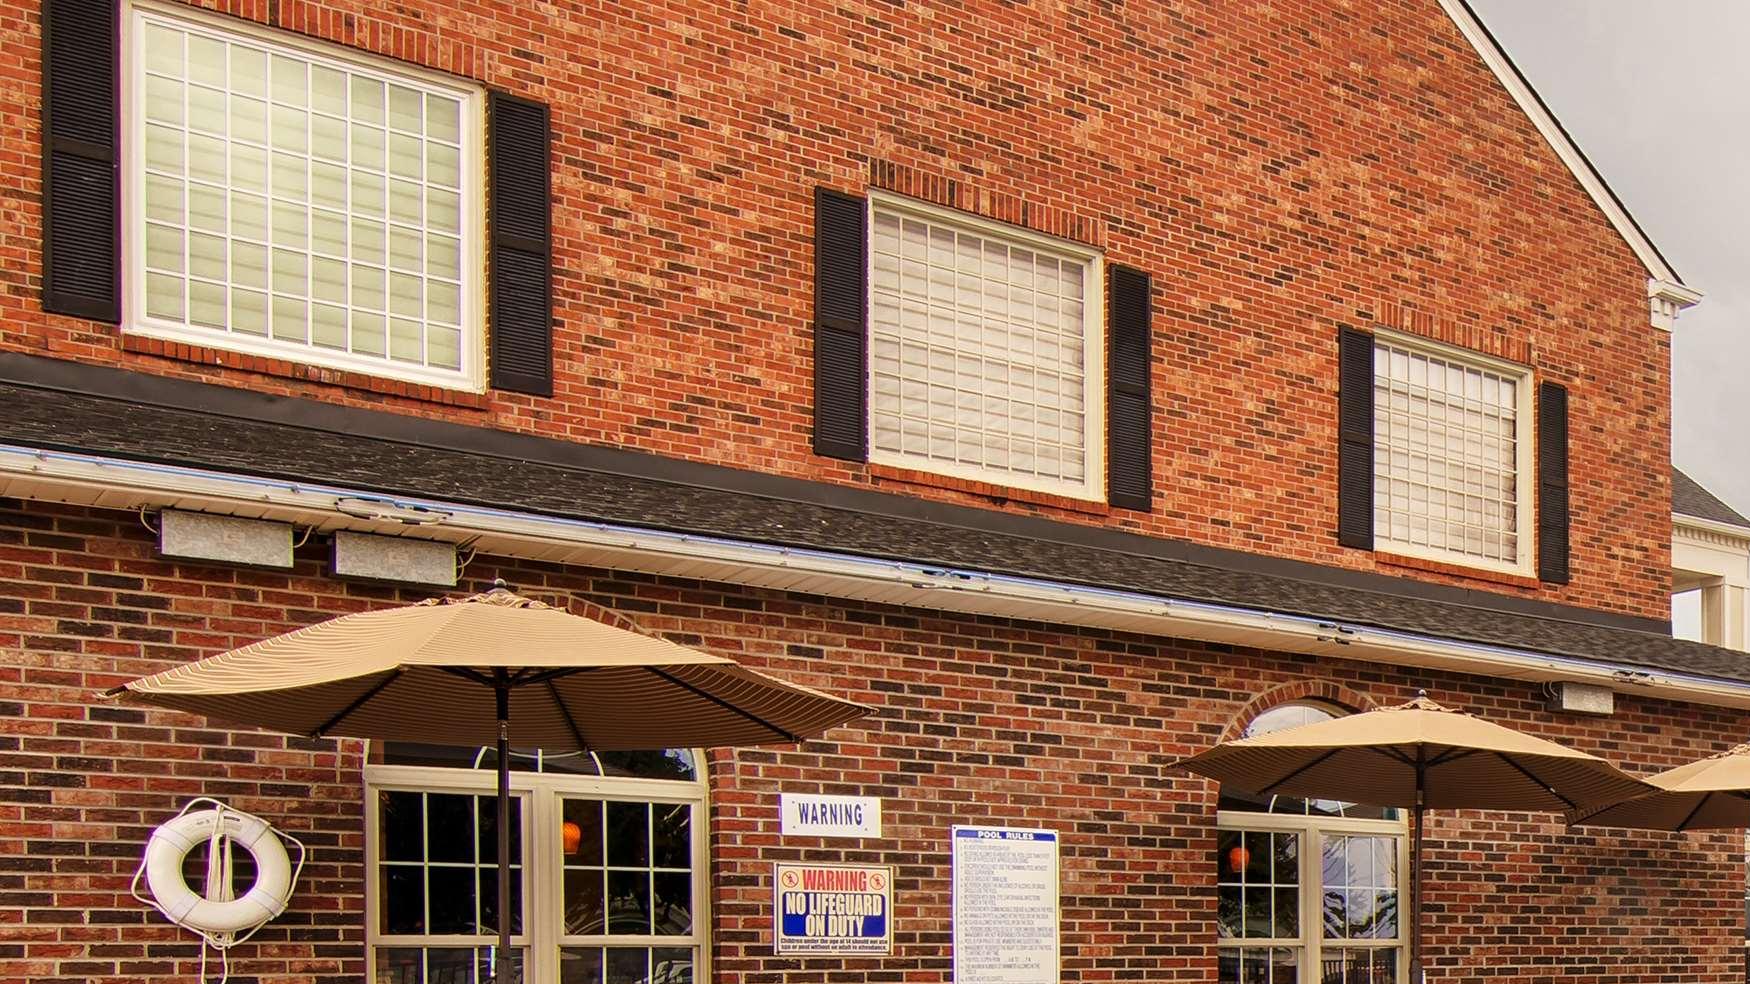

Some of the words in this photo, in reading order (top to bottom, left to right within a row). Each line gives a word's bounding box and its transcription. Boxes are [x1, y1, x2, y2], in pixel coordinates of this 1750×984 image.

[798, 803, 863, 825] WARNING
[977, 831, 1002, 839] POOL
[1006, 831, 1034, 840] RULES
[802, 869, 867, 891] WARNING
[785, 892, 806, 915] NO
[809, 893, 882, 916] LIFEGUARD
[805, 914, 825, 937] ON
[828, 915, 865, 937] DUTY
